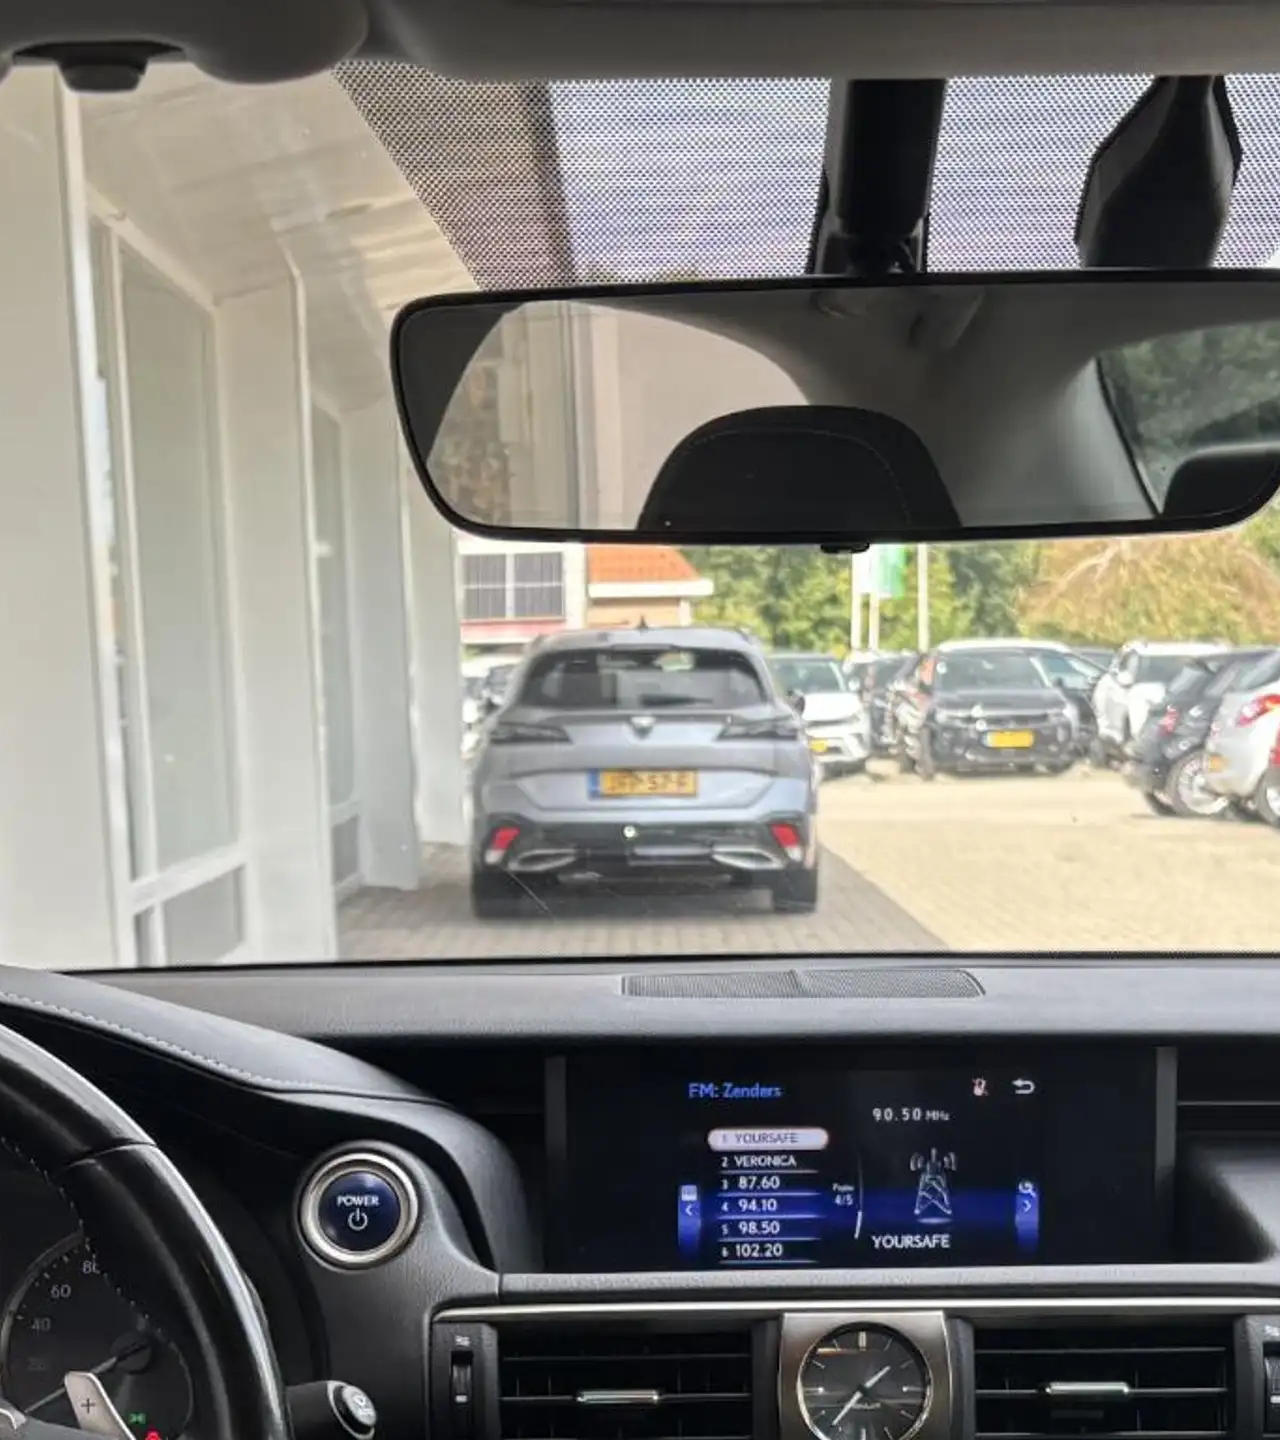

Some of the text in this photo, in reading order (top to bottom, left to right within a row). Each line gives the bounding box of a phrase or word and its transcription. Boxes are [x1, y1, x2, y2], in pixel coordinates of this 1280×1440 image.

[688, 1083, 783, 1098] FM: Zenders
[872, 1108, 921, 1121] 90.50
[734, 1133, 799, 1144] YOURSAFE
[721, 1155, 797, 1167] 2 VERONICA
[738, 1176, 780, 1189] 87.60
[337, 1195, 380, 1207] POWER
[738, 1199, 777, 1212] 94.10
[738, 1221, 780, 1234] 98.50
[872, 1234, 950, 1249] YOURSAFE
[736, 1244, 783, 1257] 102.20
[50, 1284, 71, 1298] 60
[31, 1318, 50, 1331] 40
